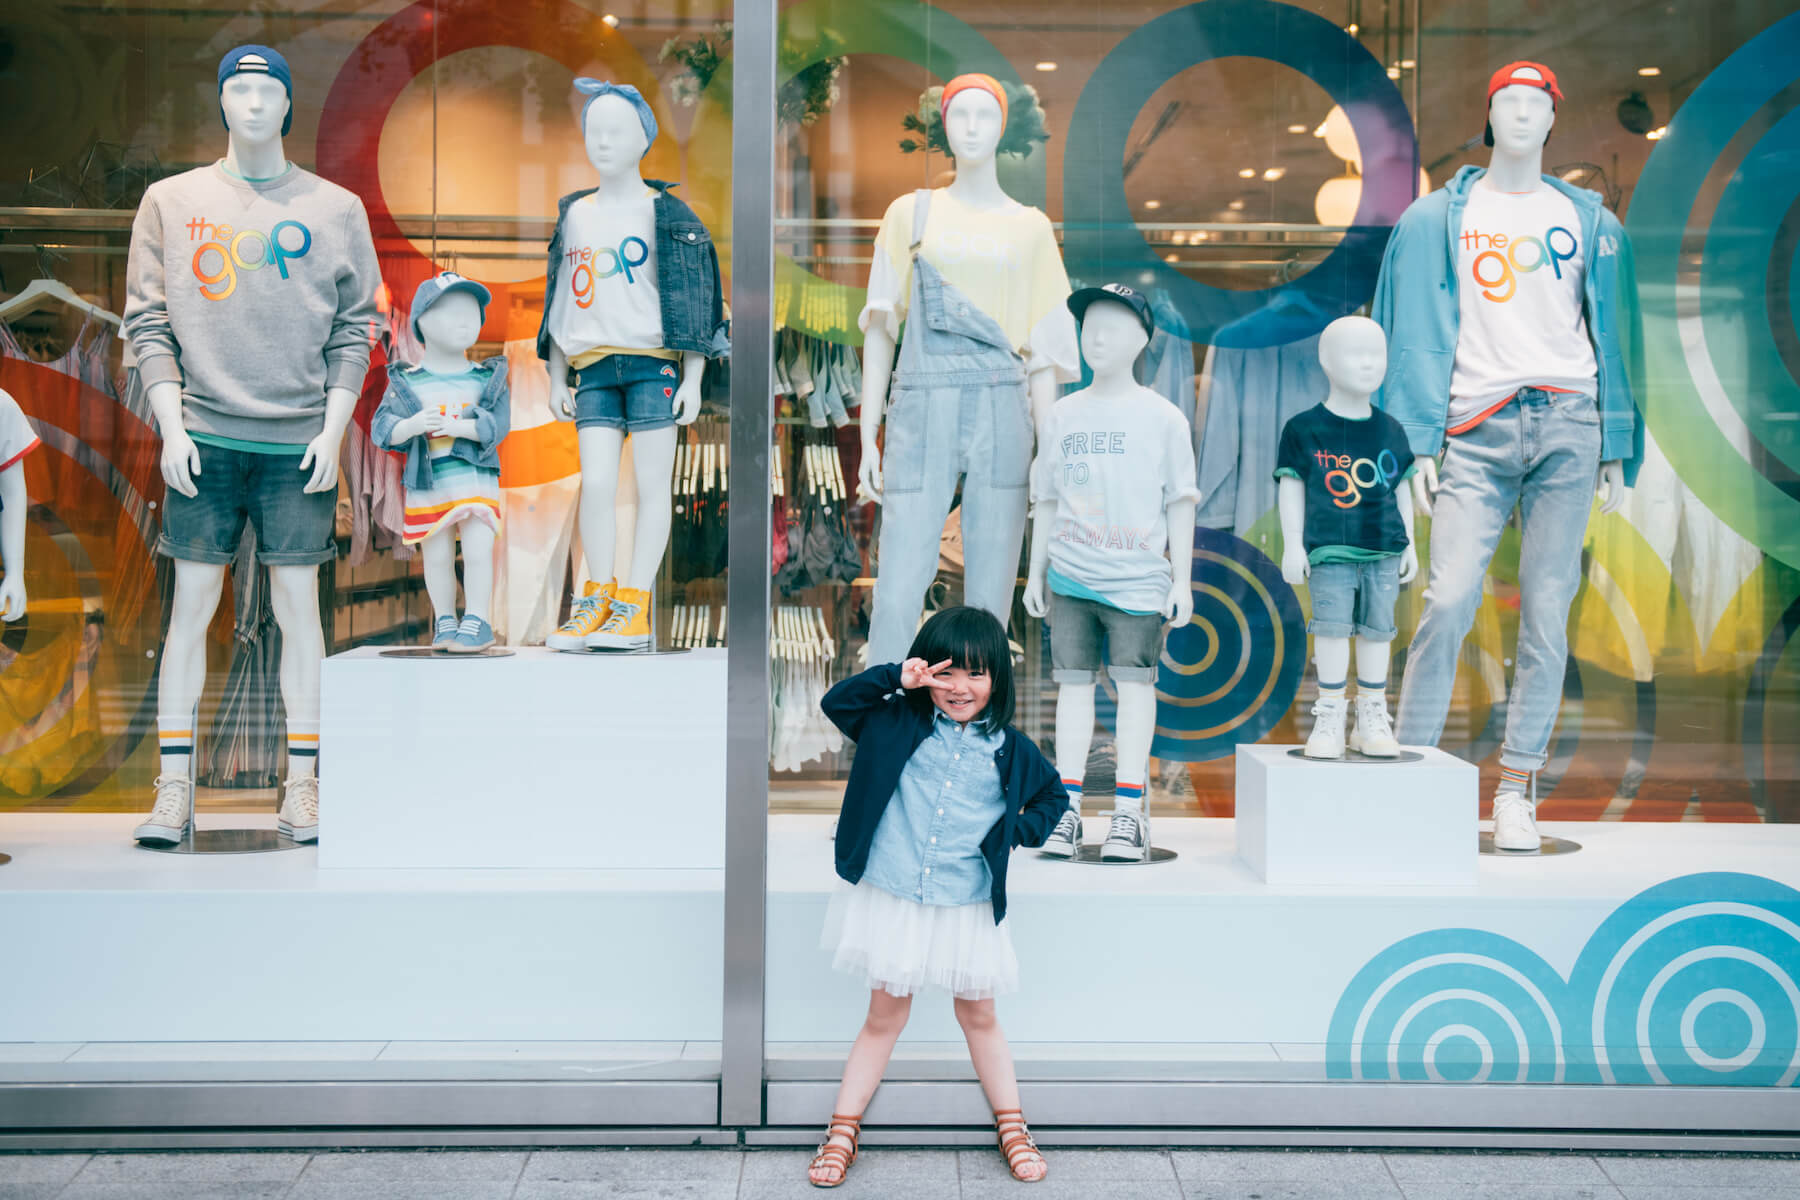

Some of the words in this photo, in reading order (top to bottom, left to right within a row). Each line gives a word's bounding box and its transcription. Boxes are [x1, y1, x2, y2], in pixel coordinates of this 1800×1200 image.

[185, 217, 233, 240] the
[1460, 229, 1508, 250] the
[191, 220, 312, 301] gap
[565, 246, 592, 266] the
[1472, 226, 1577, 303] gap
[572, 236, 648, 309] gap
[1061, 431, 1126, 458] FREE
[1314, 449, 1352, 468] the
[1063, 462, 1089, 487] TO
[1324, 449, 1398, 508] gap
